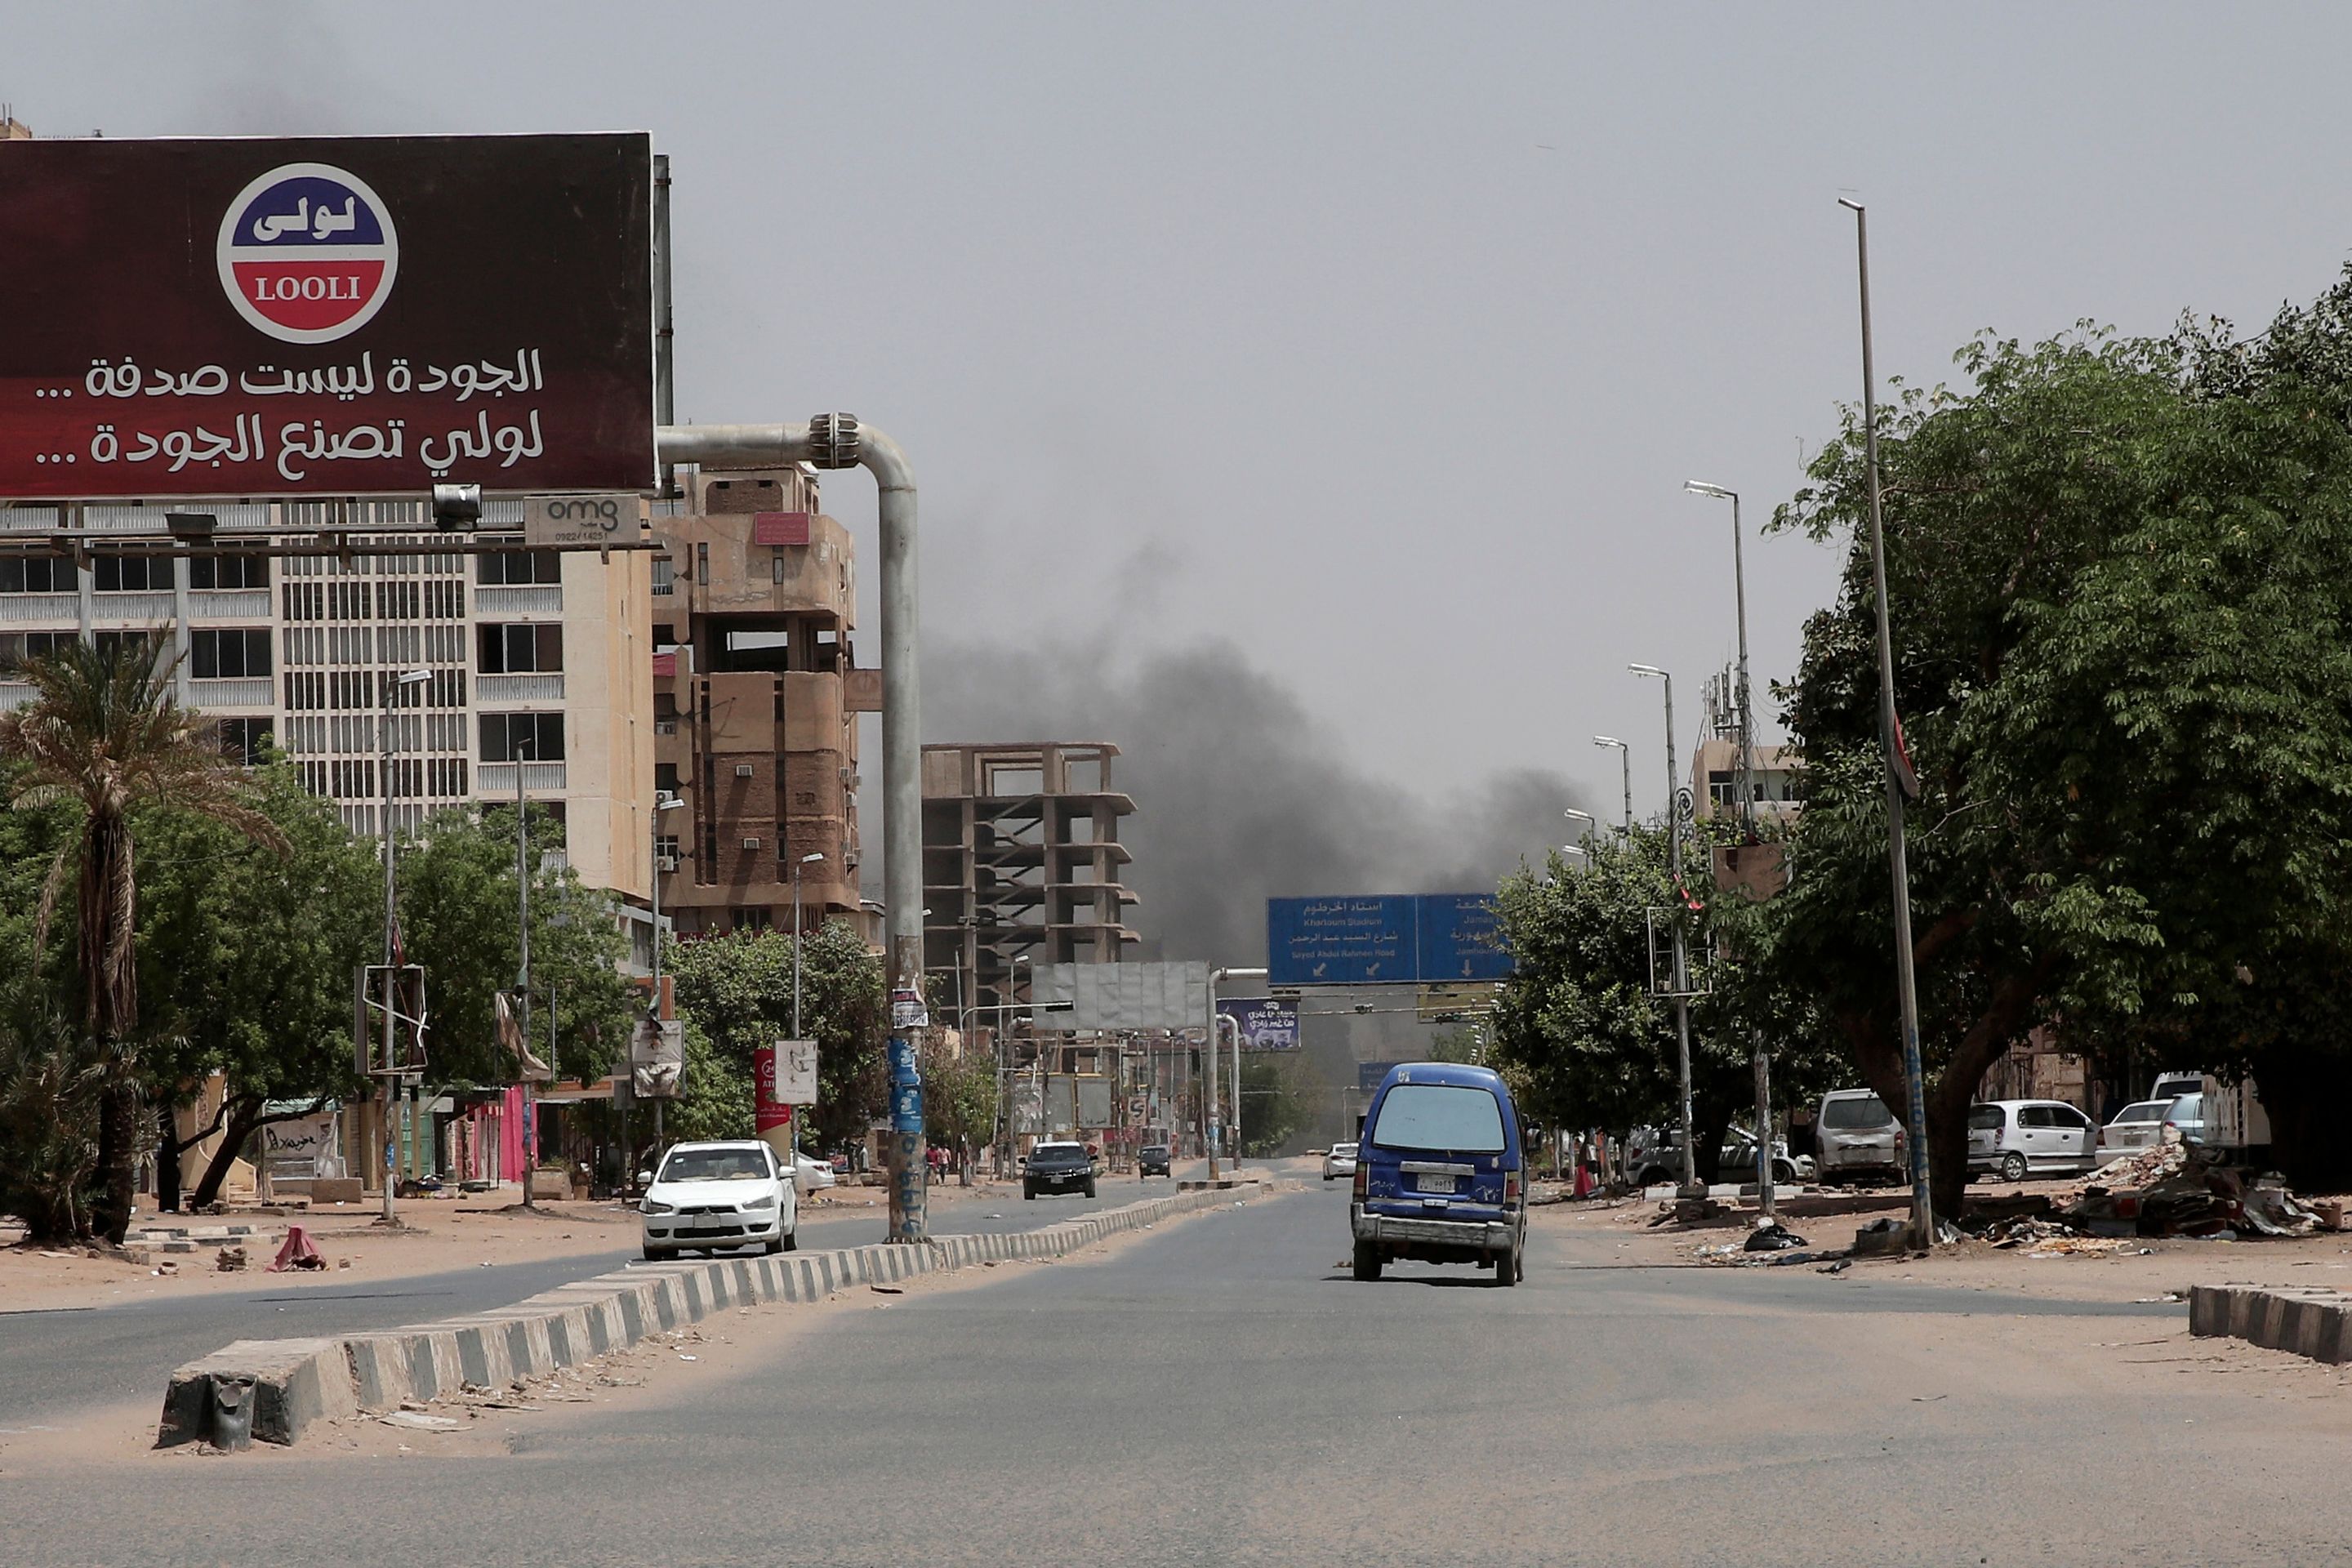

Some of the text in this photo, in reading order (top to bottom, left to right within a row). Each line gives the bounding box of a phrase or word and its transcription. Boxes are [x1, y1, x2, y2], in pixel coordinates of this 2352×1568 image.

[255, 277, 360, 301] LOOLI
[85, 356, 229, 398] صدفة
[239, 350, 375, 401] ليست
[386, 348, 543, 402] الجودة
[90, 412, 265, 473] الجودة
[277, 419, 406, 481] تصنع
[419, 408, 544, 478] لولي
[547, 499, 619, 532] omg
